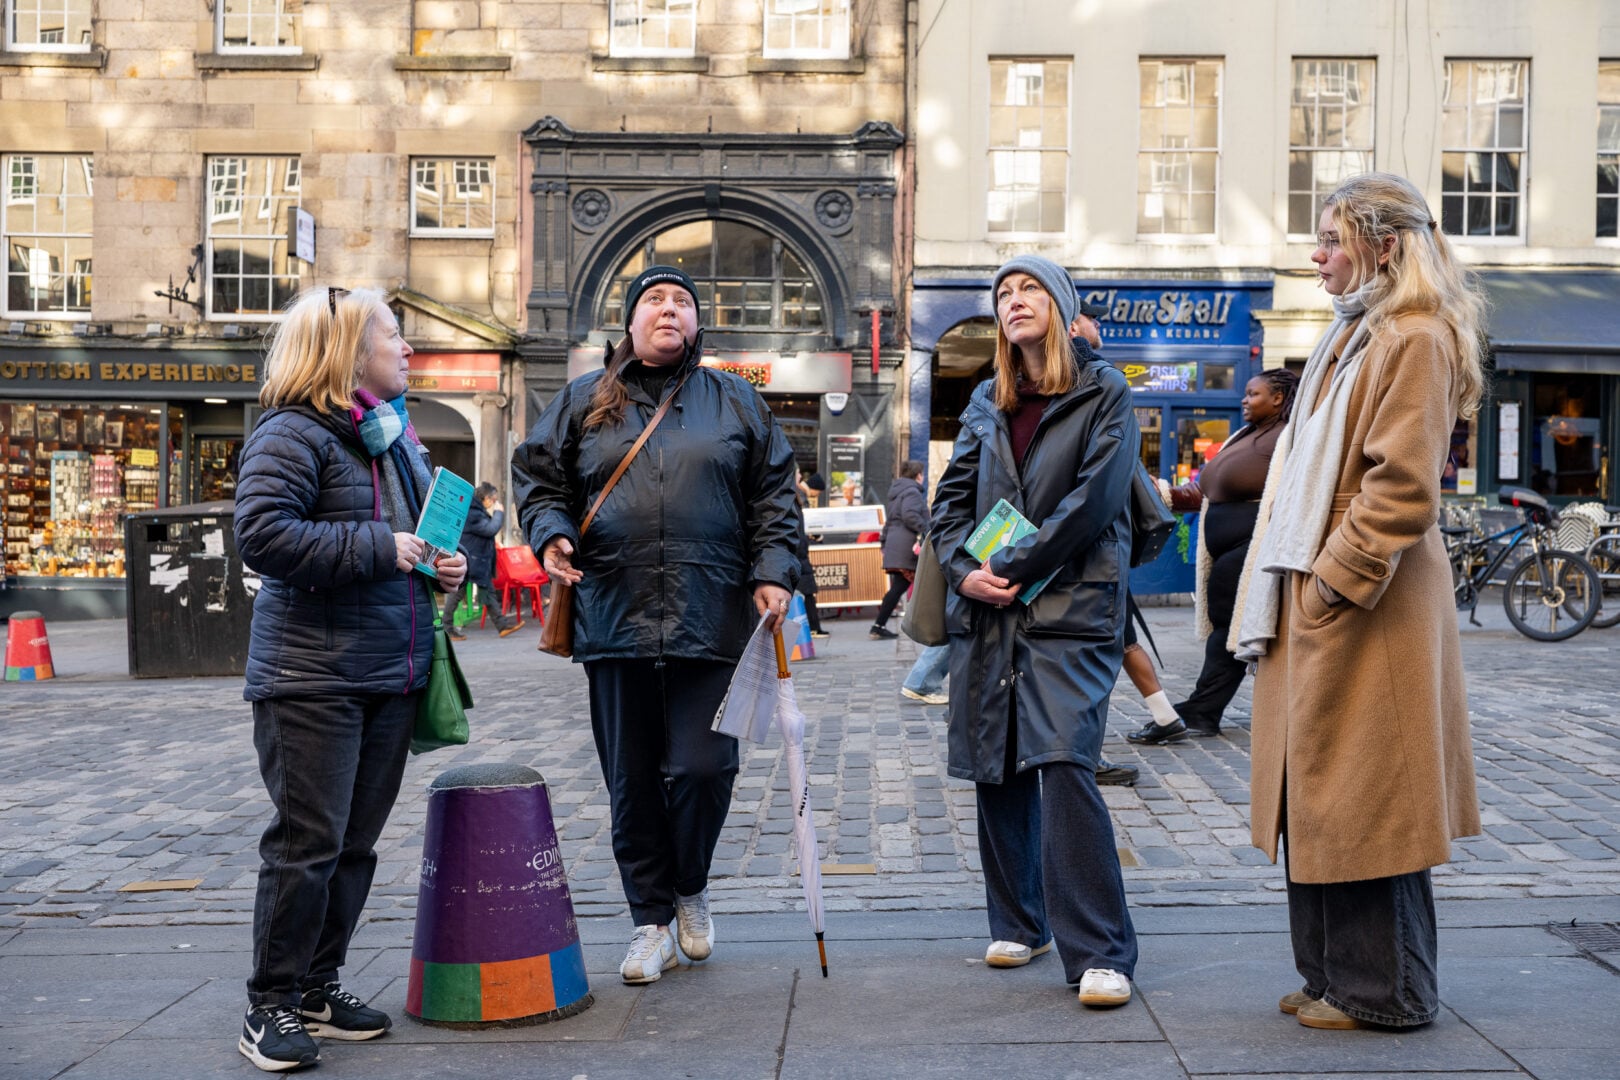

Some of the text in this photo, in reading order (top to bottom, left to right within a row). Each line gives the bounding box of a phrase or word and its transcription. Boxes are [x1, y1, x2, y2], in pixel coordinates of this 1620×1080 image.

[1101, 327, 1142, 338] IZZAS
[1166, 328, 1220, 339] KEBABS
[100, 362, 257, 382] EXPERIENCE
[1150, 365, 1177, 378] FISH
[1151, 379, 1188, 391] CHIPS
